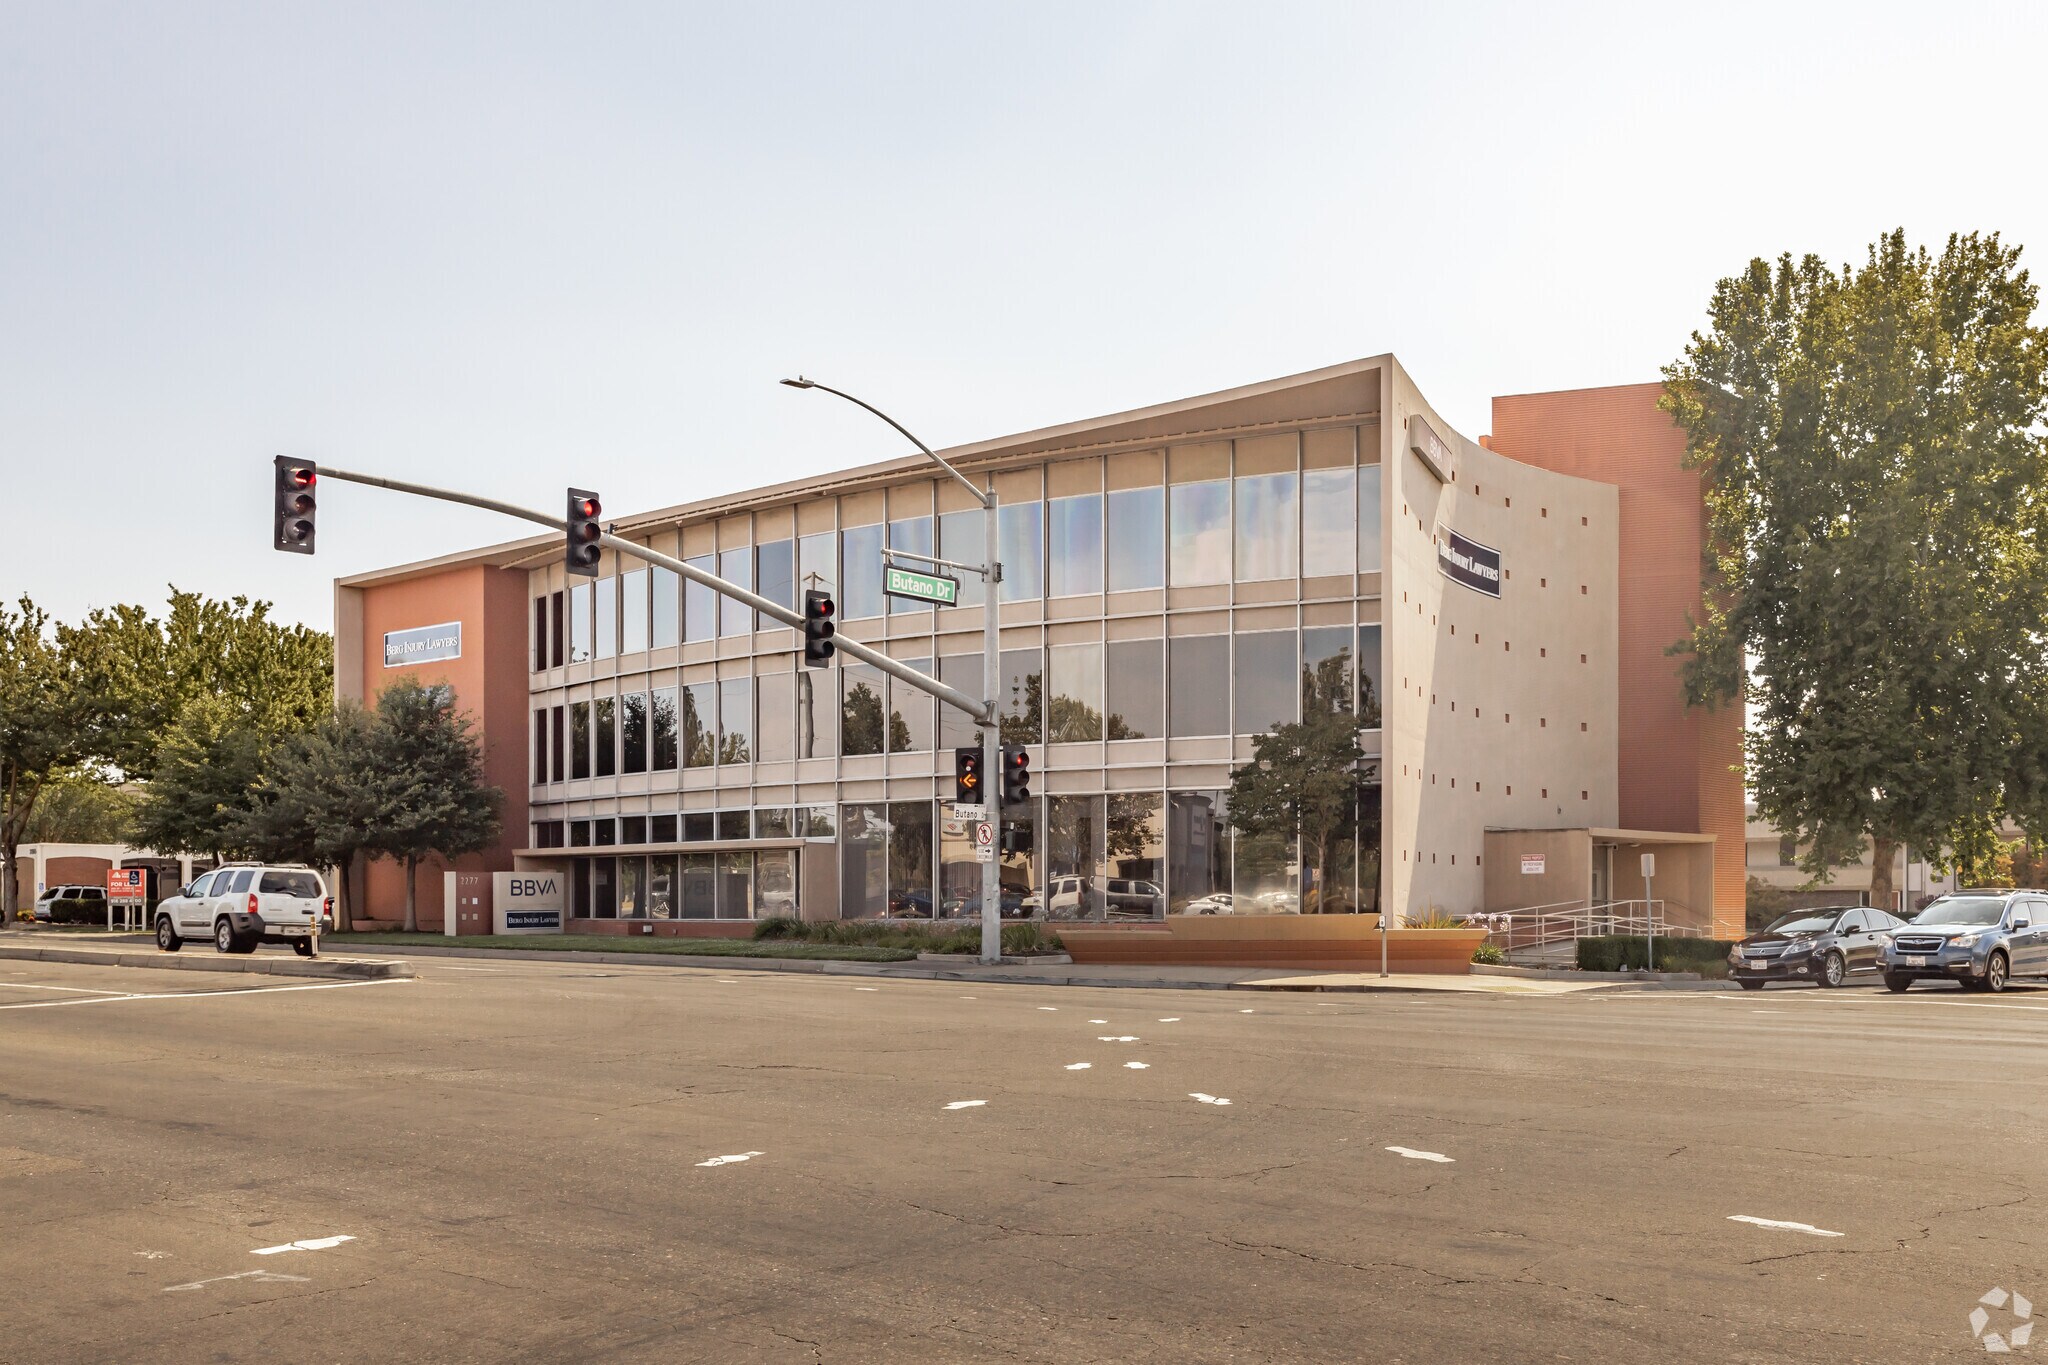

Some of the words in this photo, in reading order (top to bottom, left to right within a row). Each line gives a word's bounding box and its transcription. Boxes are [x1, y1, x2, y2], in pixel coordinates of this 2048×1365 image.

[1469, 556, 1499, 582] LAWYERS
[892, 573, 933, 595] Butano
[937, 582, 951, 598] Dr
[386, 644, 404, 656] BERG
[404, 641, 426, 653] INJURY
[427, 637, 458, 650] LAWYERS
[955, 809, 978, 819] Butano
[460, 877, 479, 886] 2277
[510, 878, 557, 897] BBVA
[508, 916, 524, 924] BERG
